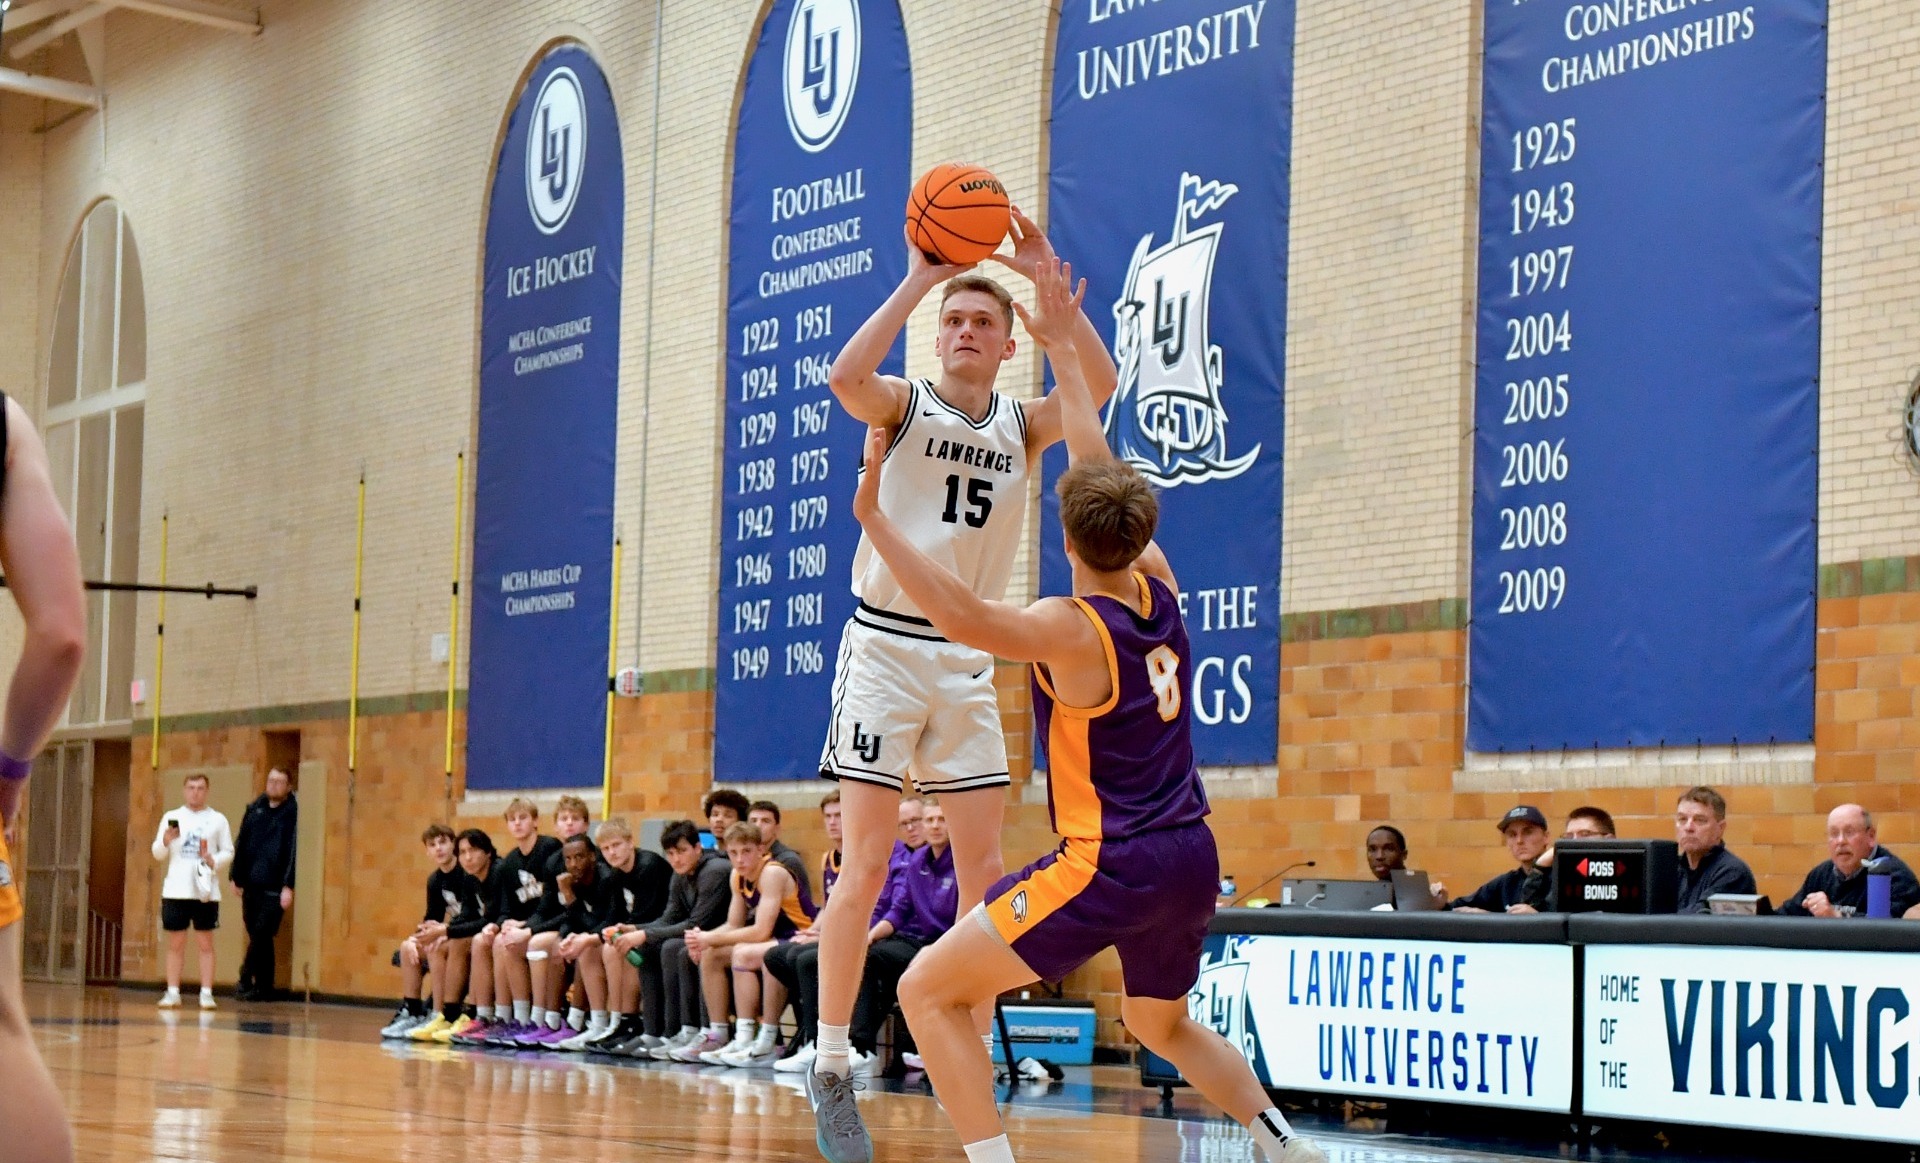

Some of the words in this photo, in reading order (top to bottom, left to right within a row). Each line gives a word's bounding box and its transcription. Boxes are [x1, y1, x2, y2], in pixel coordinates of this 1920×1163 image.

[1564, 0, 1715, 41] CONFER
[1077, 0, 1266, 100] UNIVERSITY
[1542, 6, 1754, 93] CHAMPIONSHIPS
[1511, 117, 1576, 173] 1925
[771, 168, 866, 223] FOOTBALL
[1510, 181, 1575, 235] 1943
[771, 216, 861, 261] CONFERENCE
[507, 266, 531, 298] ICE
[535, 246, 597, 290] HOCKEY
[758, 247, 873, 298] CHAMPIONSHIPS
[1508, 245, 1574, 299] 1997
[537, 315, 592, 346] CONFERENCE
[741, 317, 779, 356] 1922
[795, 304, 832, 343] 1951
[1505, 310, 1572, 361] 2004
[514, 342, 584, 376] CHAMPIONSHIPS
[740, 364, 778, 403] 1924
[793, 351, 830, 391] 1966
[739, 411, 776, 448] 1929
[792, 400, 831, 438] 1967
[1503, 373, 1569, 425] 2005
[738, 457, 775, 495] 1938
[791, 448, 829, 485] 1975
[925, 437, 1012, 473] LAWRENCE
[1500, 437, 1569, 488] 2006
[736, 505, 774, 542] 1942
[789, 495, 828, 533] 1979
[941, 473, 993, 529] 15
[1500, 501, 1568, 551] 2008
[735, 552, 772, 588] 1946
[788, 543, 826, 580] 1980
[1498, 565, 1566, 614] 2009
[734, 599, 771, 634] 1947
[786, 592, 823, 627] 1981
[1199, 586, 1258, 631] THE
[732, 646, 769, 681] 1949
[785, 640, 823, 676] 1986
[1145, 644, 1181, 723] 8
[1584, 884, 1618, 900] BONUS
[1588, 861, 1615, 877] POSS
[1288, 949, 1467, 1014] LAWRENCE
[1600, 974, 1640, 1003] HOME
[1600, 1018, 1618, 1045] OF
[1659, 978, 1920, 1110] VIKING
[1318, 1023, 1539, 1098] UNIVERSITY
[1600, 1061, 1628, 1089] THE
